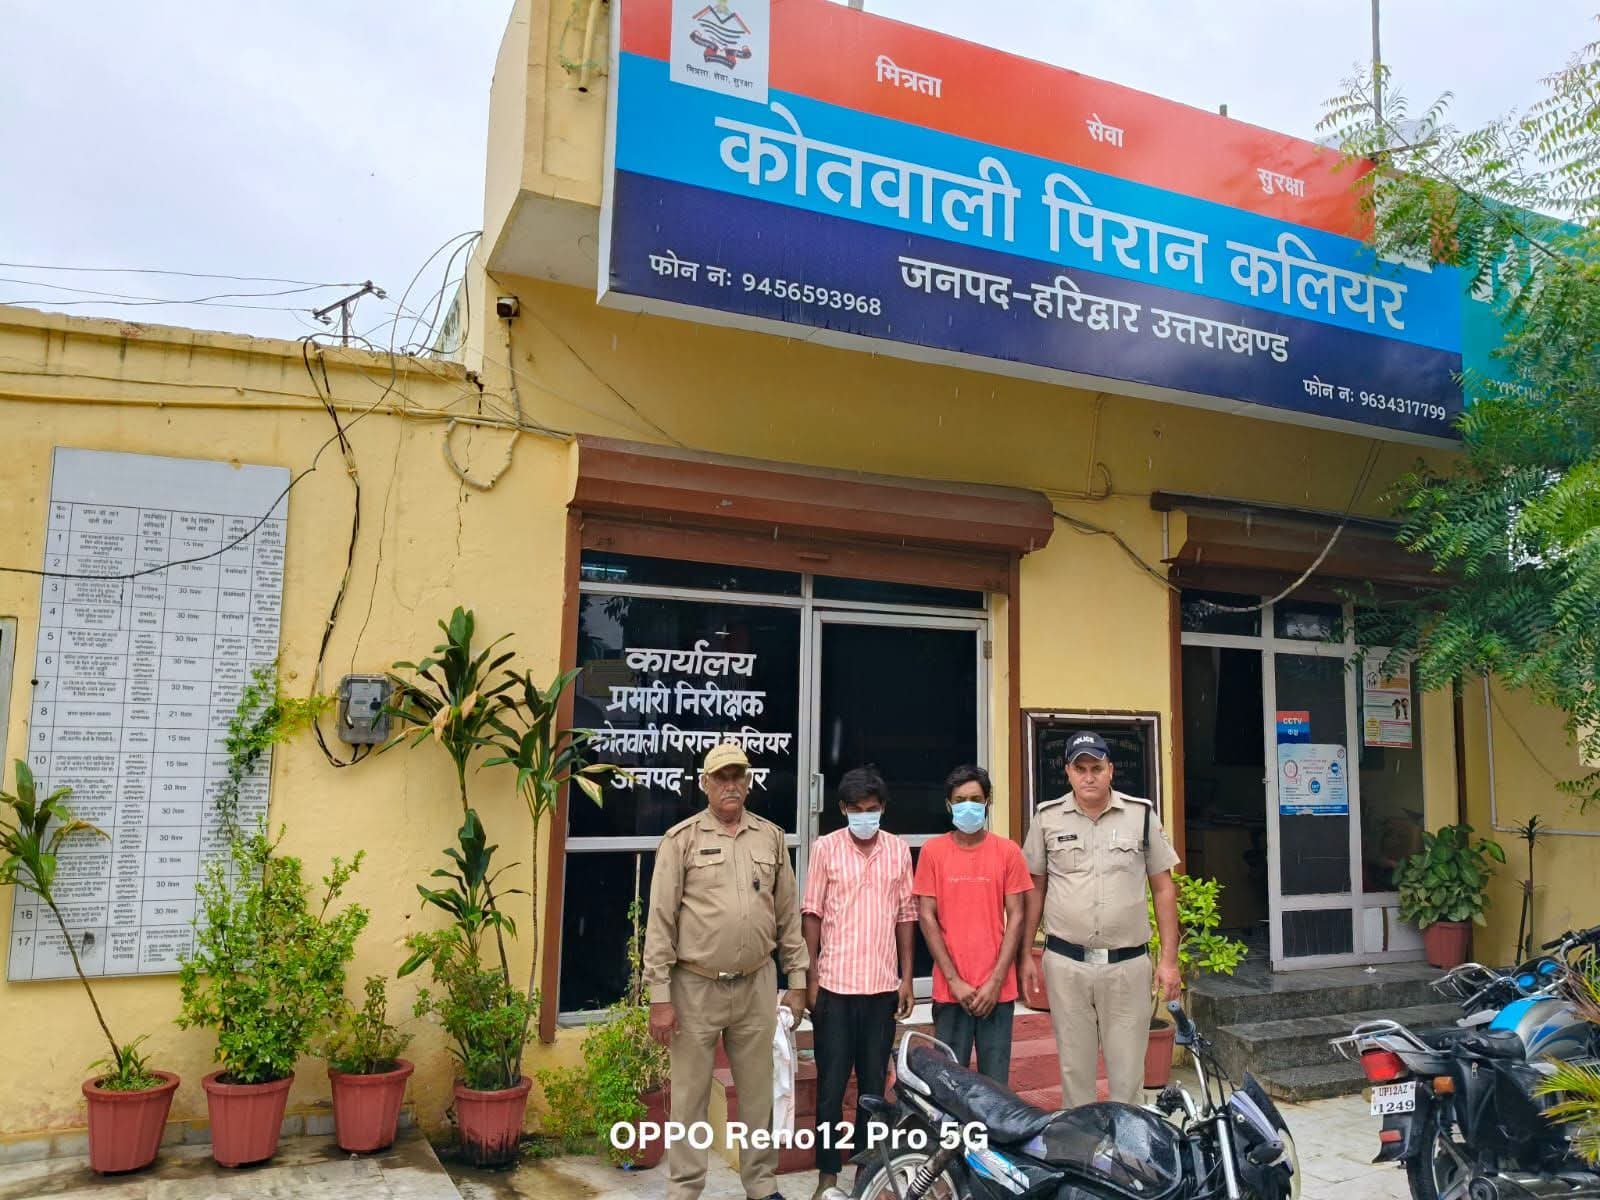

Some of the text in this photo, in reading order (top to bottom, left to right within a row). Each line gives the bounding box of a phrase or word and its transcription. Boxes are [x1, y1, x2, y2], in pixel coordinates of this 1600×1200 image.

[875, 54, 942, 98] मित्रता
[1085, 113, 1124, 148] सेवा
[1257, 166, 1305, 198] सुरक्षा
[714, 101, 1022, 243] कोतवाली
[1042, 172, 1208, 283] पिरान
[1226, 231, 1407, 330] कलियर
[649, 249, 700, 282] फोन
[742, 273, 881, 316] 9456593968
[1150, 306, 1289, 363] उत्तराखण्ड
[1302, 375, 1334, 400] फोन
[1359, 391, 1446, 421] 9634317799
[53, 559, 60, 567] 2
[51, 583, 58, 592] 3
[49, 607, 56, 616] 4
[47, 632, 54, 641] 5
[45, 656, 52, 664] 6
[625, 639, 757, 677] कार्यालय
[43, 681, 50, 689] 7
[606, 680, 766, 720] प्रभारी निरीक्षक
[40, 706, 48, 716] 8
[1282, 717, 1303, 725] CCTV
[38, 732, 46, 741] 9
[34, 755, 47, 765] 10
[18, 936, 31, 946] 17
[1379, 1099, 1415, 1113] 1249
